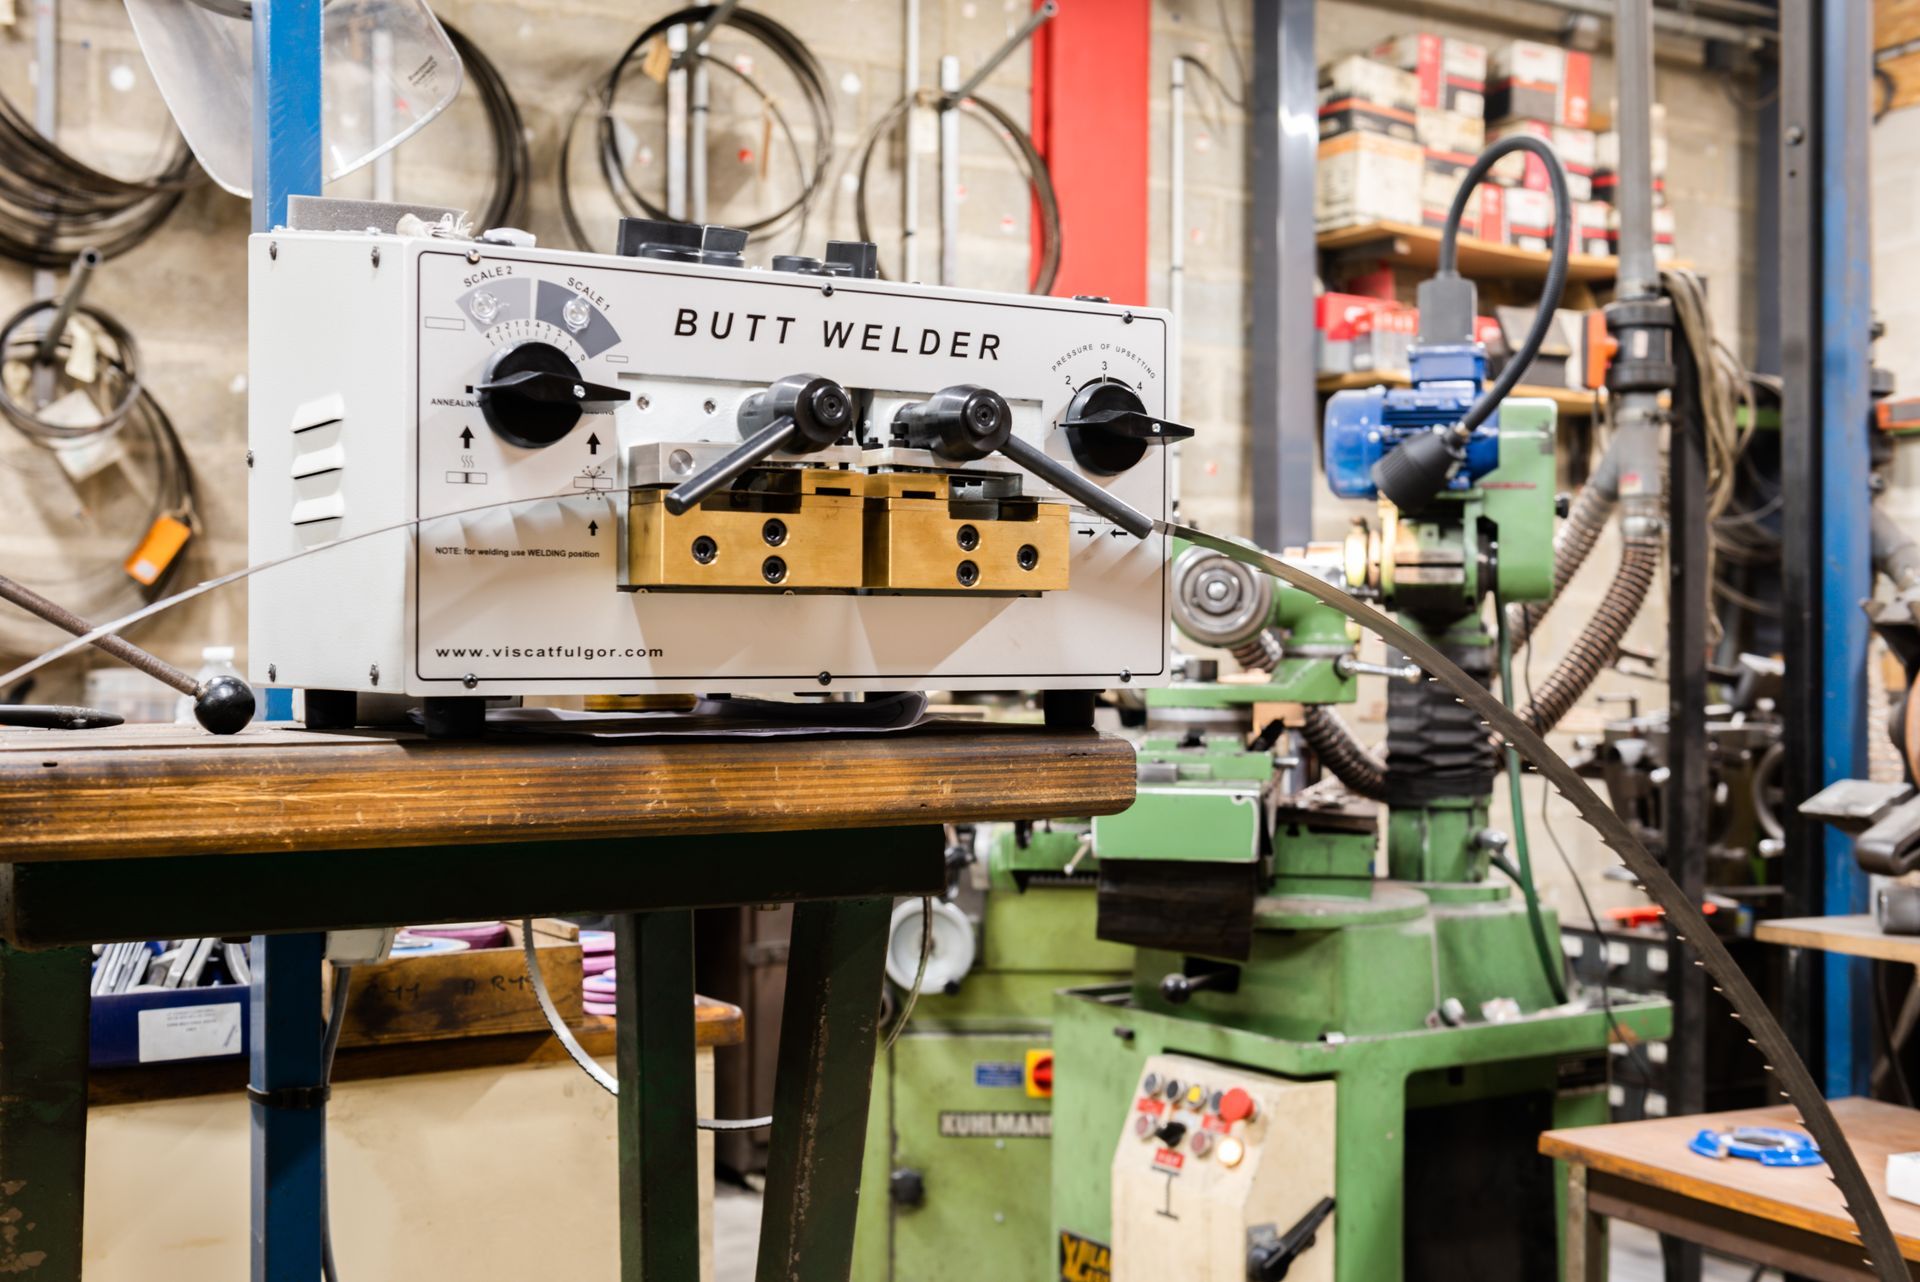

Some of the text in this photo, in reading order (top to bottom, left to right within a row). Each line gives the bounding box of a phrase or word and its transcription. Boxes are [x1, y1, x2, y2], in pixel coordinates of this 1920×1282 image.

[464, 265, 513, 287] SCALE 2
[567, 277, 610, 312] SCALE 1
[674, 308, 1001, 360] BUTT WELDER
[1052, 344, 1093, 372] PRESSURE
[1115, 346, 1156, 379] UPSETTING
[1101, 360, 1107, 371] 3
[1065, 375, 1071, 385] 2
[1136, 381, 1142, 391] 4
[431, 398, 481, 408] ANNEALING
[1052, 420, 1057, 430] 1
[435, 547, 462, 555] NOTE:
[464, 547, 475, 555] for
[477, 547, 510, 558] welding
[527, 549, 566, 558] WELDING
[568, 550, 600, 559] position
[435, 646, 664, 660] www.viscatfulgor.com
